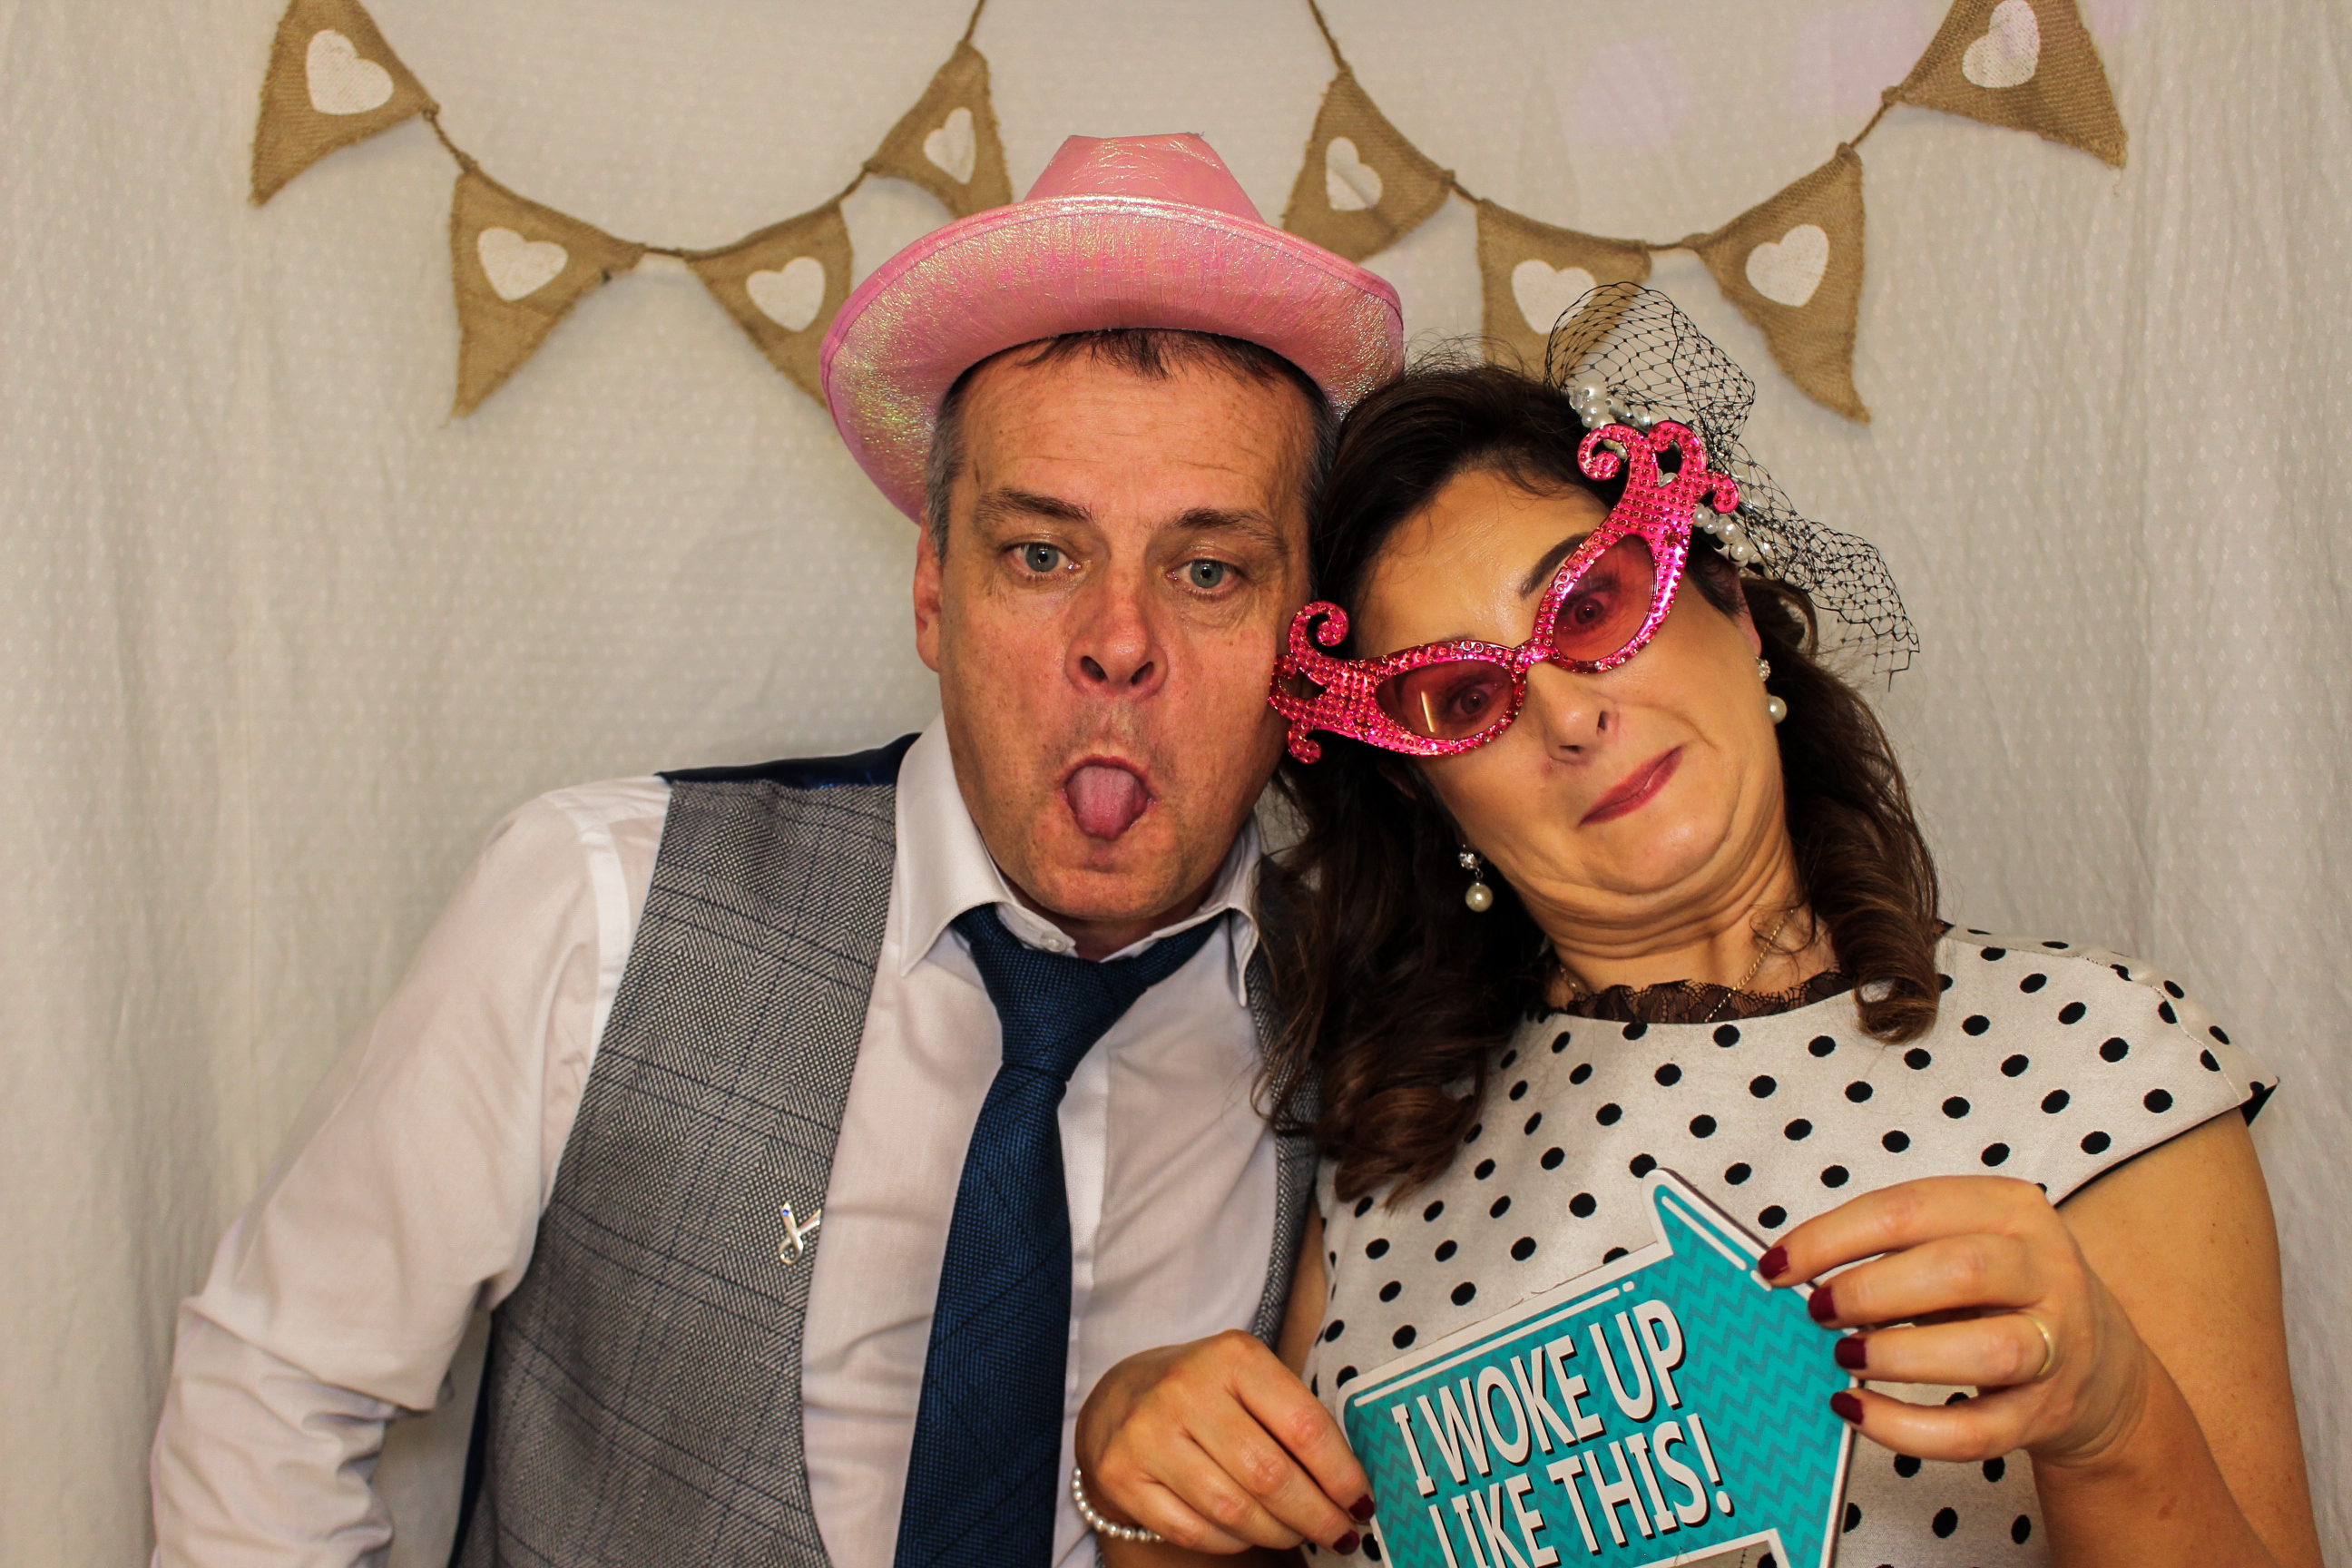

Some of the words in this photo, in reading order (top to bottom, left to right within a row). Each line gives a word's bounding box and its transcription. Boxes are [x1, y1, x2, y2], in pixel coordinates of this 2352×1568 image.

[1391, 1403, 1436, 1496] I
[1416, 1335, 1603, 1485] WOKE
[1588, 1299, 1685, 1420] UP
[1546, 1413, 1734, 1554] THIS!
